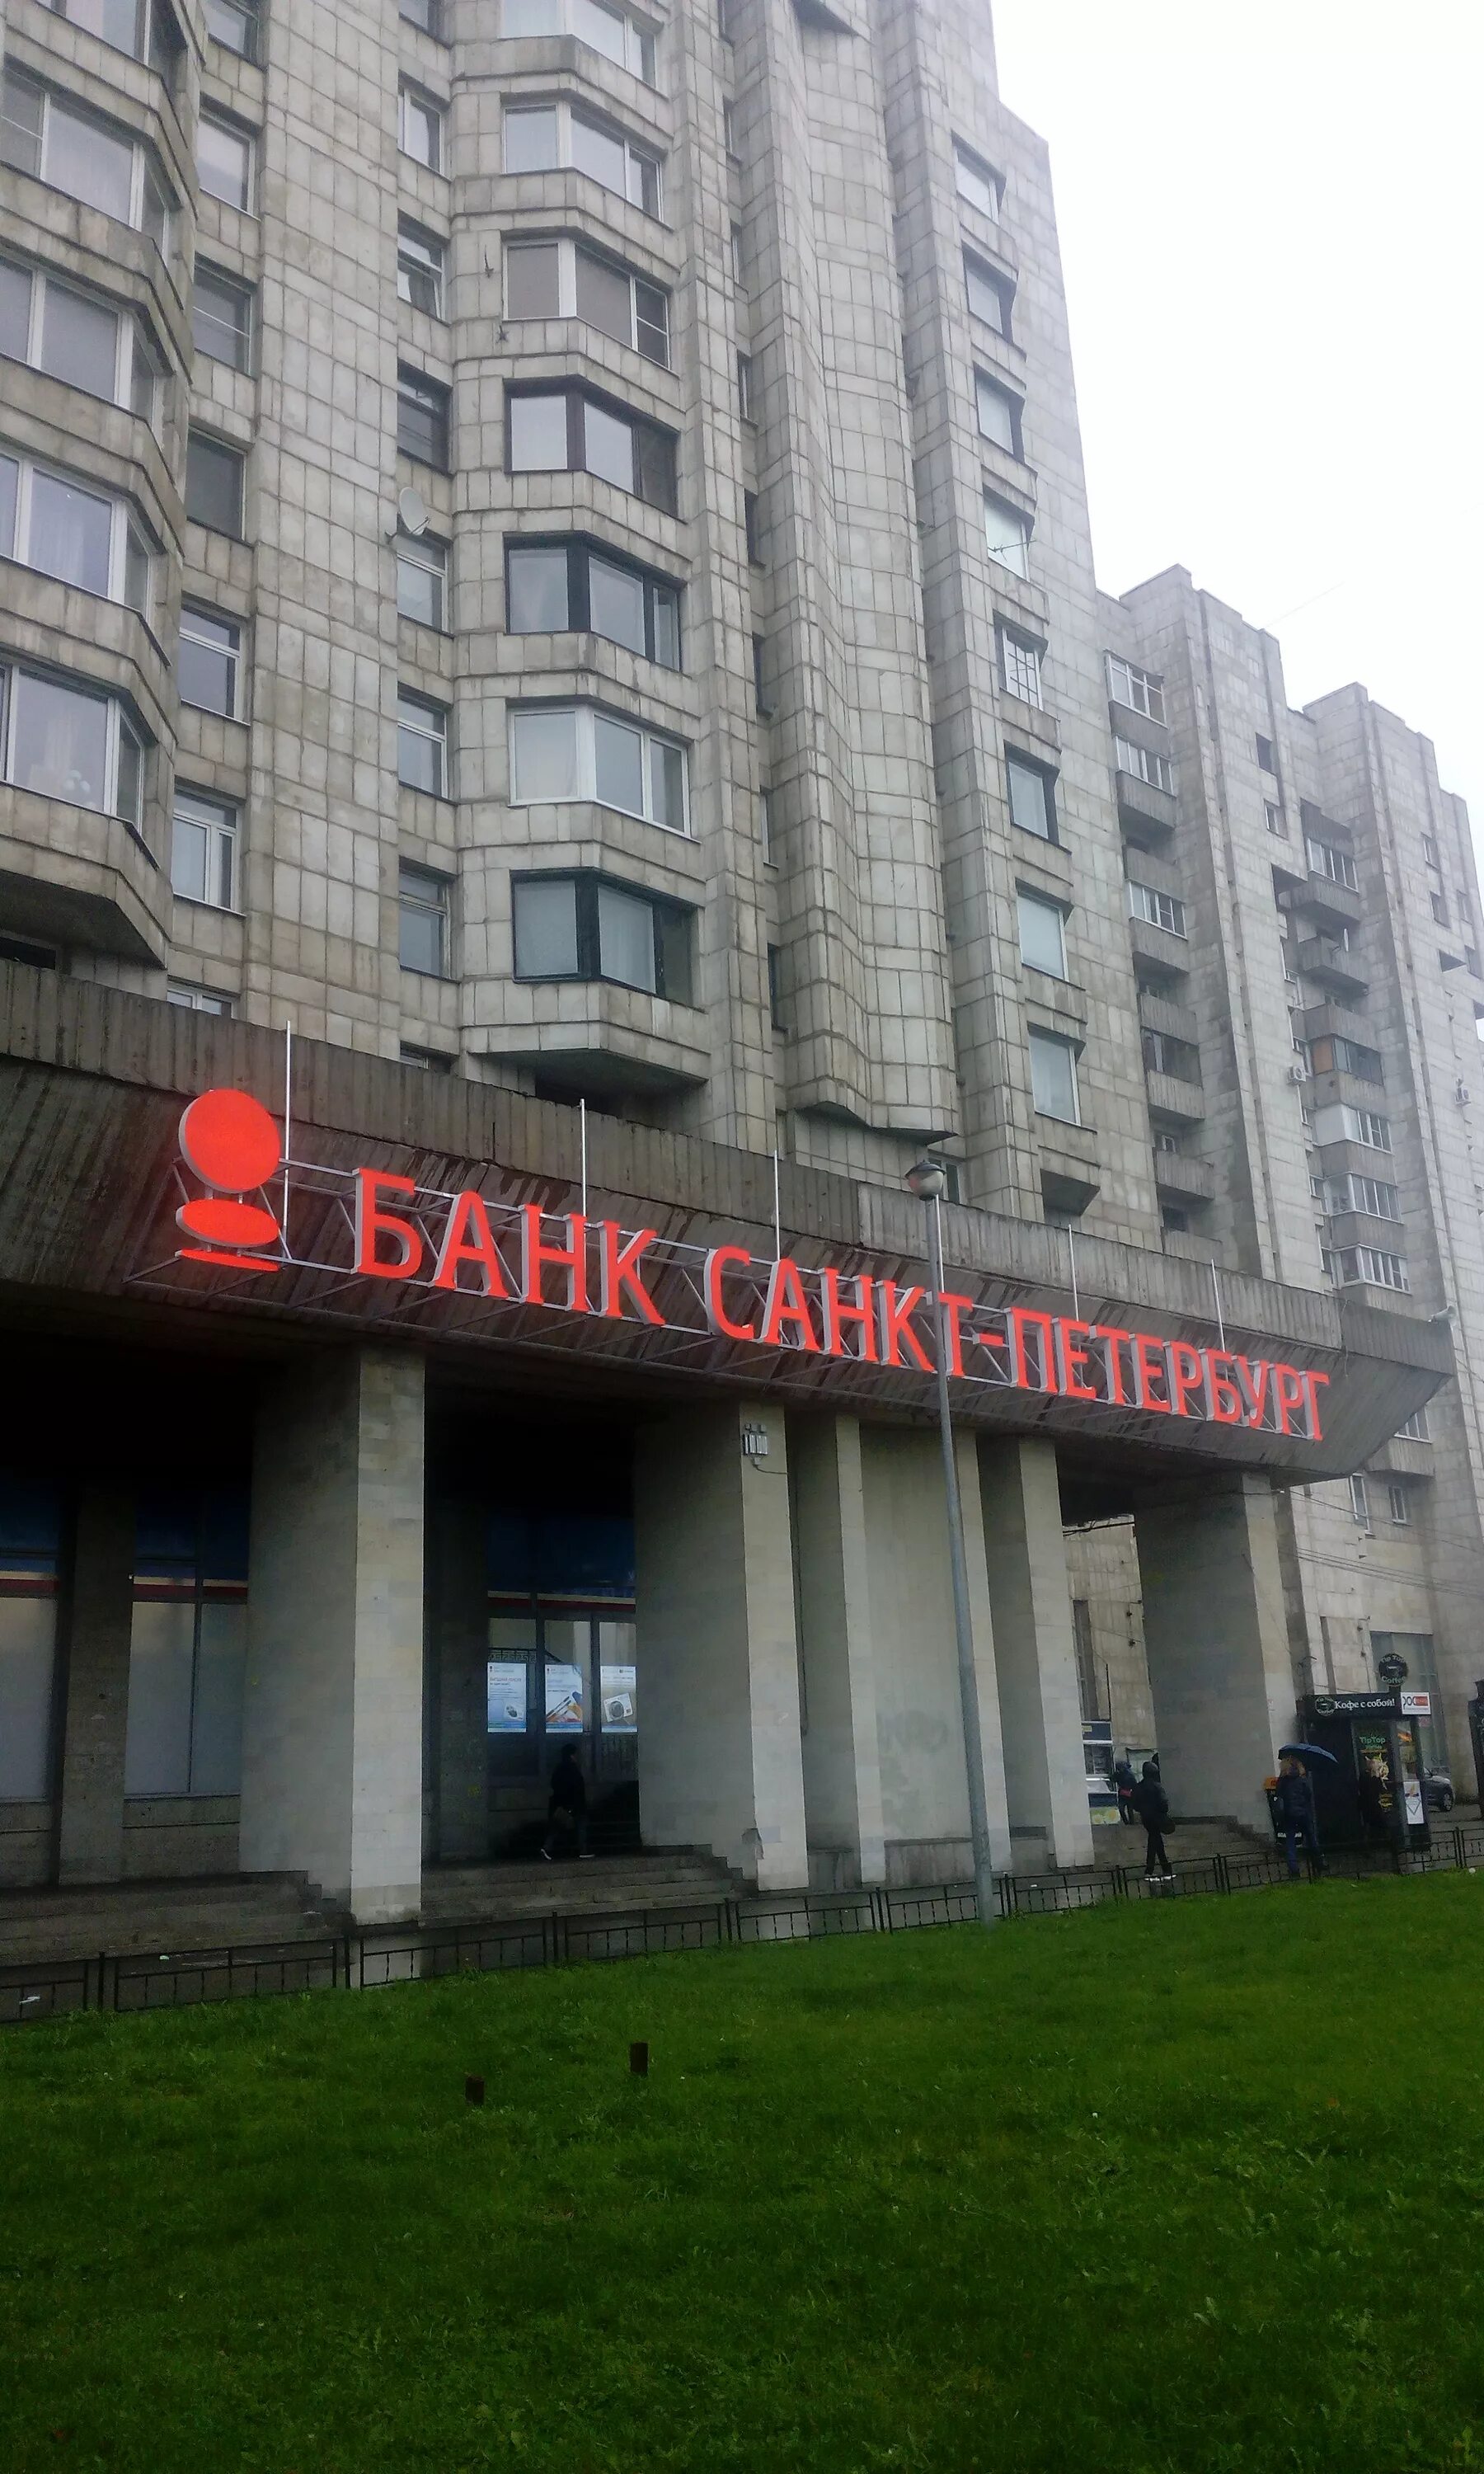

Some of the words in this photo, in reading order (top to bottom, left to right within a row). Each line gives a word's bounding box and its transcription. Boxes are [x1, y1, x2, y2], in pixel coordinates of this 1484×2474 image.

[352, 1168, 666, 1326] БАНК
[703, 1245, 1330, 1442] САНКТ-ПЕТЕРБУРГ
[1335, 1700, 1359, 1711] Кофе
[1367, 1698, 1395, 1708] собой!
